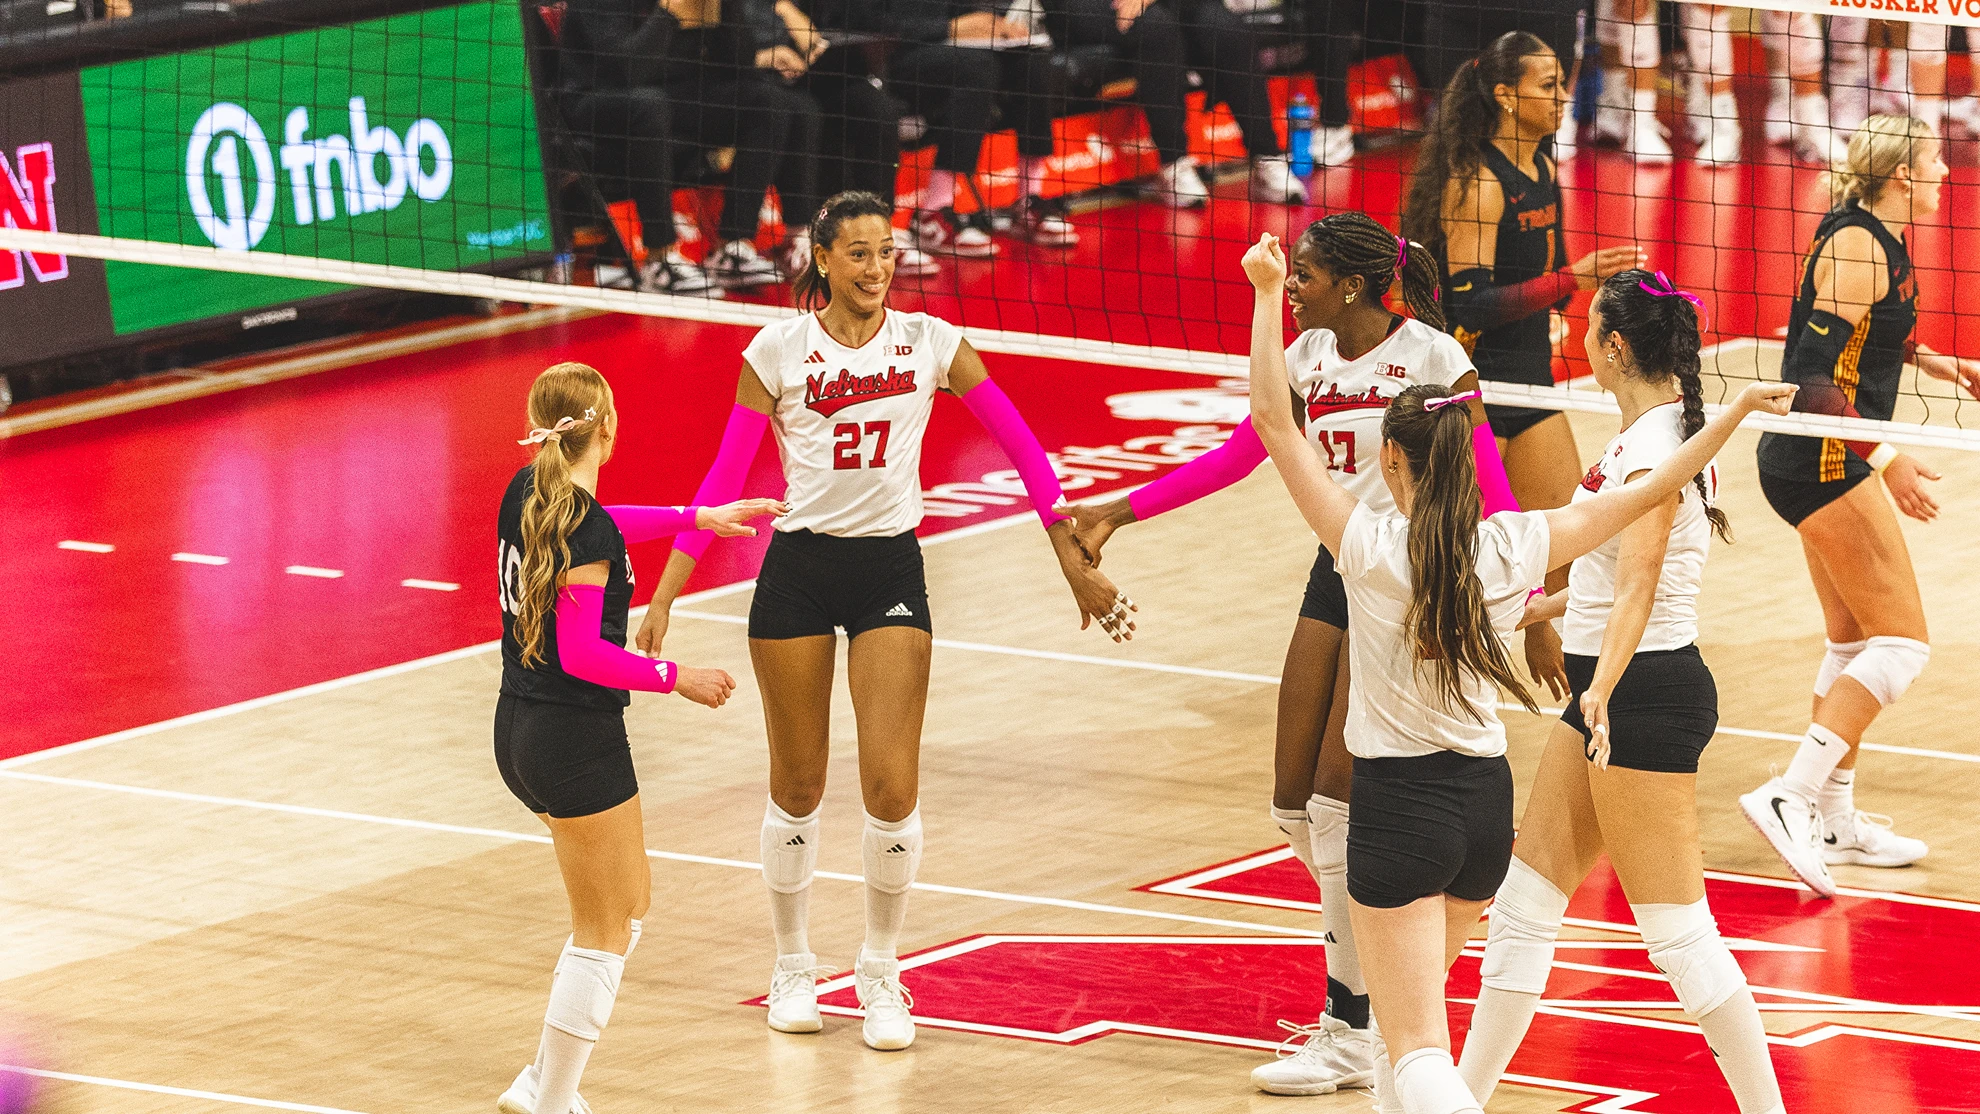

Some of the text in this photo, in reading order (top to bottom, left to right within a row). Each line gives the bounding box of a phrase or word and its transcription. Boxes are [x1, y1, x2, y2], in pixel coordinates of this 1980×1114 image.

[1830, 0, 1939, 14] SKER
[280, 96, 453, 225] fnbo
[804, 366, 917, 407] Nebraska
[833, 420, 891, 470] 27
[1318, 430, 1357, 474] 17
